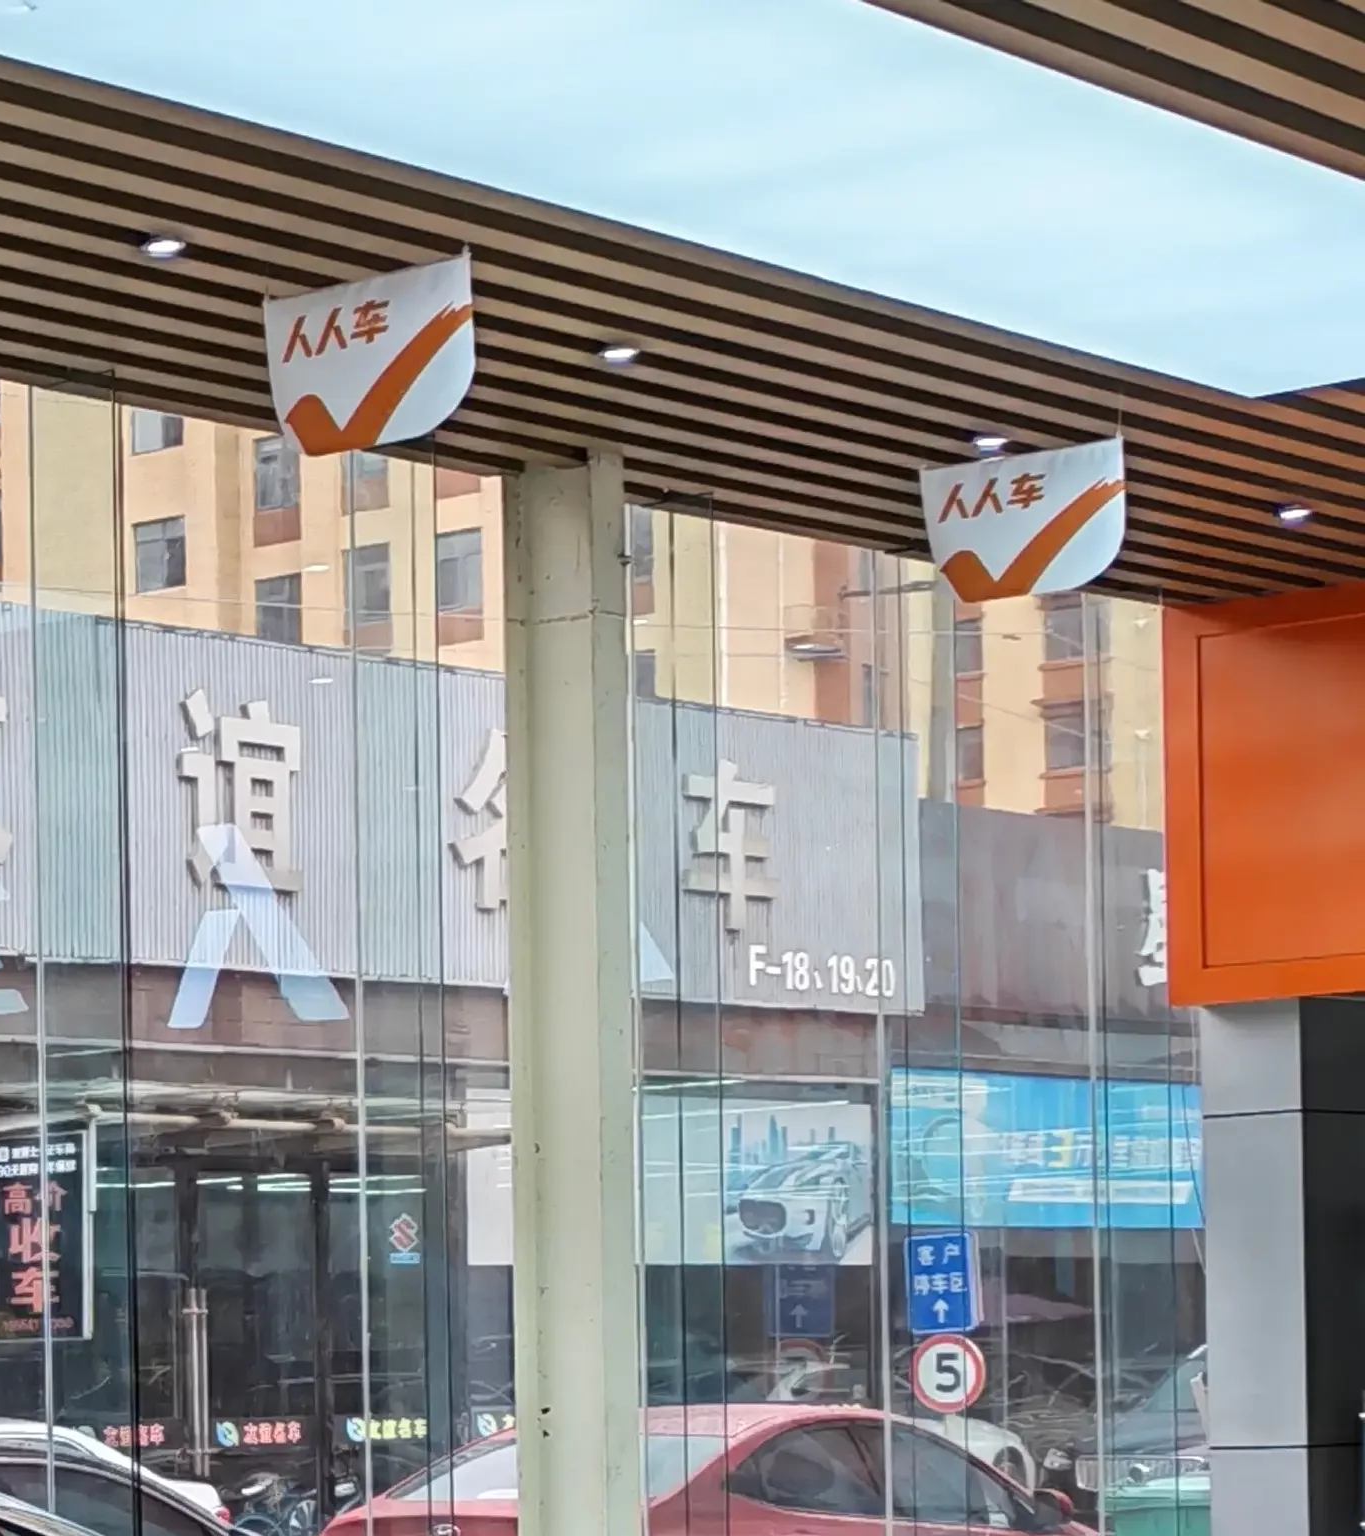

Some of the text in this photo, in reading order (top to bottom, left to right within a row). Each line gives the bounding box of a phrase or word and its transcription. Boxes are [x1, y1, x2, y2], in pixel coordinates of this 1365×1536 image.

[281, 299, 391, 363] 人人车
[938, 472, 1046, 524] 人人车
[917, 1243, 962, 1267] 客户
[914, 1271, 968, 1296] 停车区
[936, 1352, 962, 1393] 5
